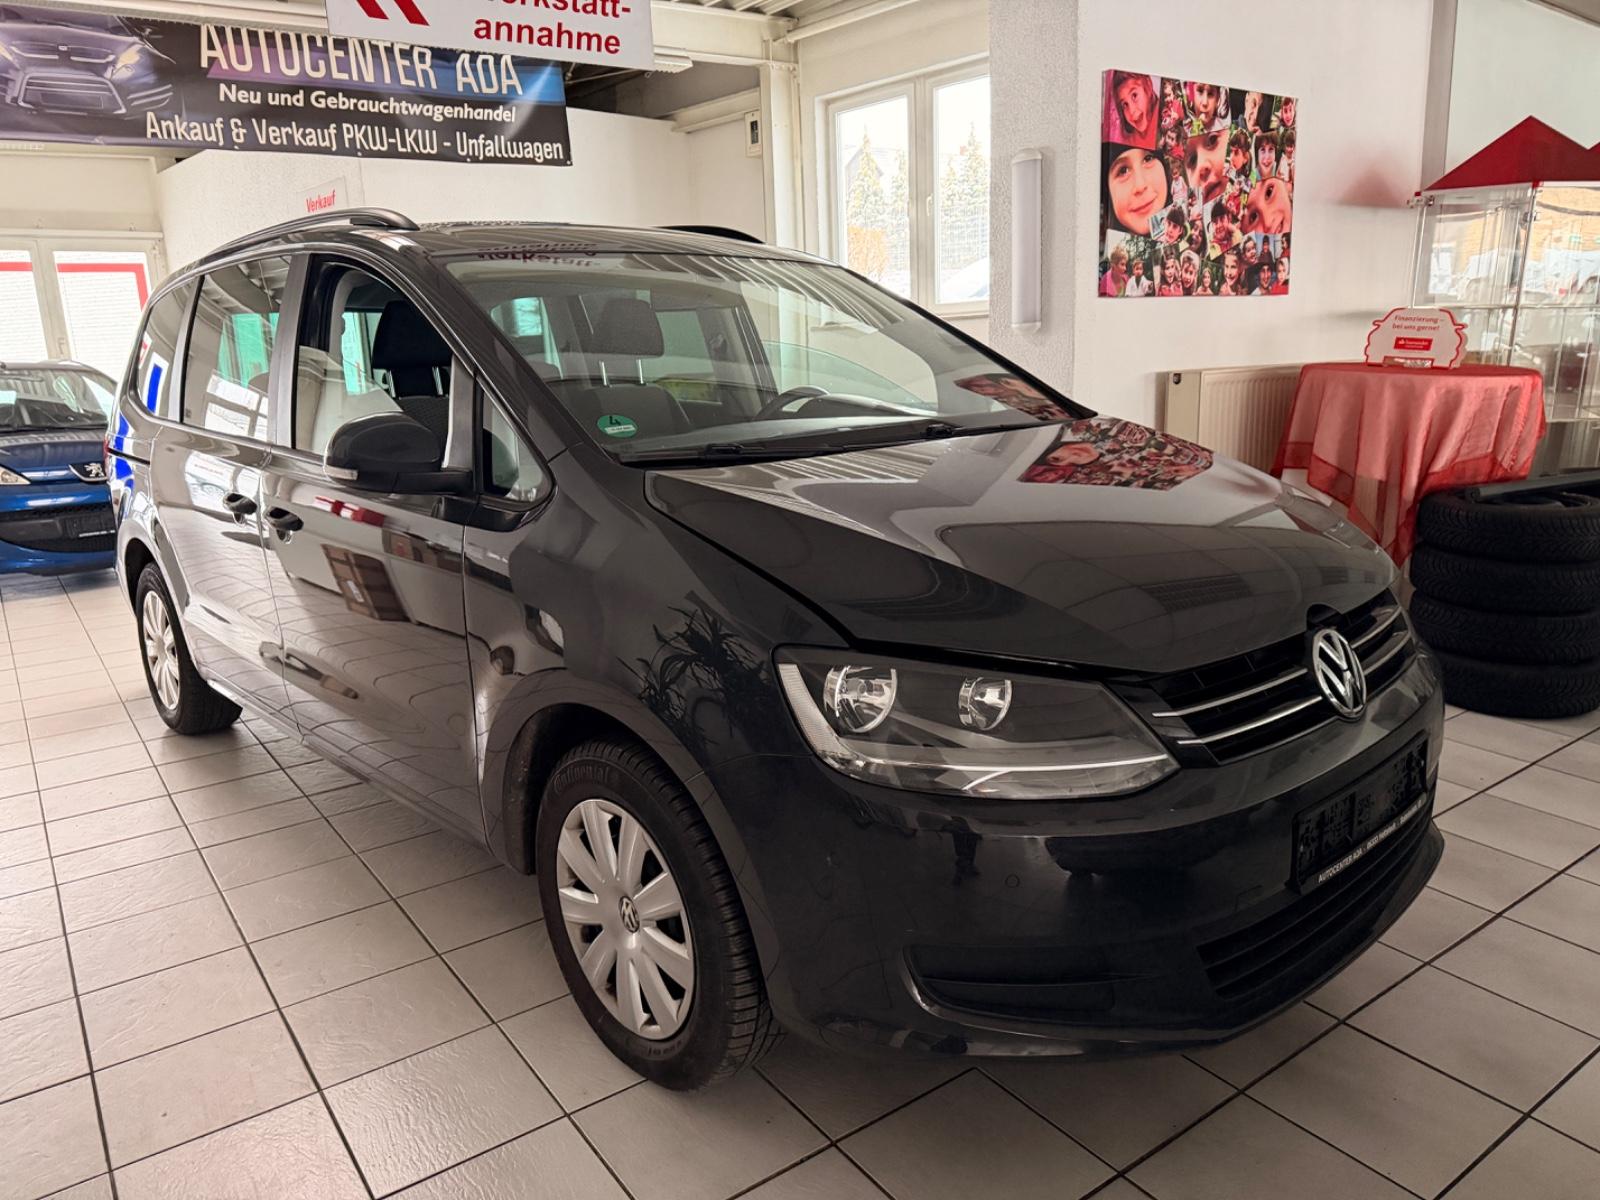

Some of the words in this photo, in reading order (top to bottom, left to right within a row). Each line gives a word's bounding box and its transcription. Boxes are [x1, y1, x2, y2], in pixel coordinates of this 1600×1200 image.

[474, 18, 620, 54] annahme
[200, 24, 438, 90] AUTOCENTER
[456, 53, 523, 95] ADA
[219, 83, 261, 104] Neu
[268, 89, 304, 107] und
[310, 91, 516, 122] Gebrauchtwagenhandel
[146, 111, 224, 146] Ankauf
[230, 118, 247, 143] &
[252, 118, 336, 151] Verkauf
[342, 123, 438, 154] PKW-LKW
[456, 131, 564, 163] Unfallwagen
[306, 188, 336, 213] Verkauf
[1394, 315, 1439, 324] Finanzierung
